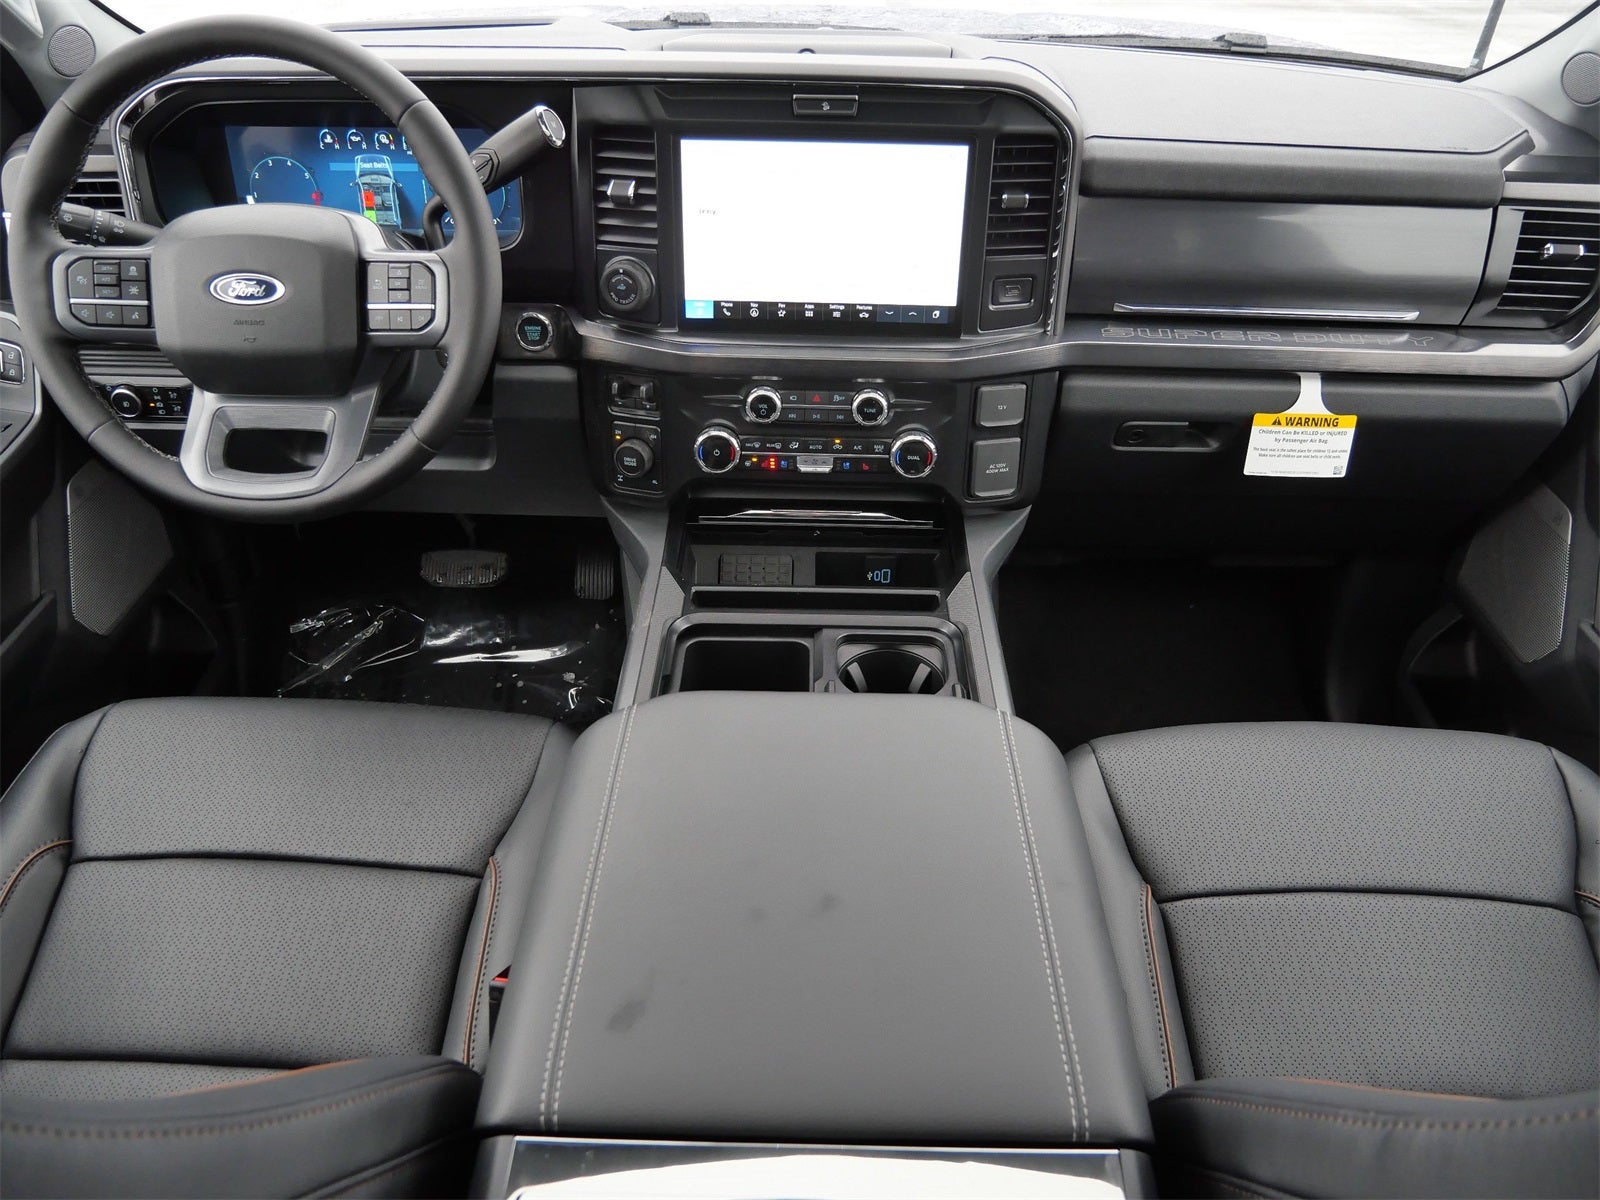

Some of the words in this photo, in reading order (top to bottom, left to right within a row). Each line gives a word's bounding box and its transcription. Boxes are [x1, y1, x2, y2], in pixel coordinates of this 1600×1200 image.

[228, 280, 266, 297] Ford
[1101, 327, 1281, 342] SUPER
[1285, 416, 1340, 428] WARNING
